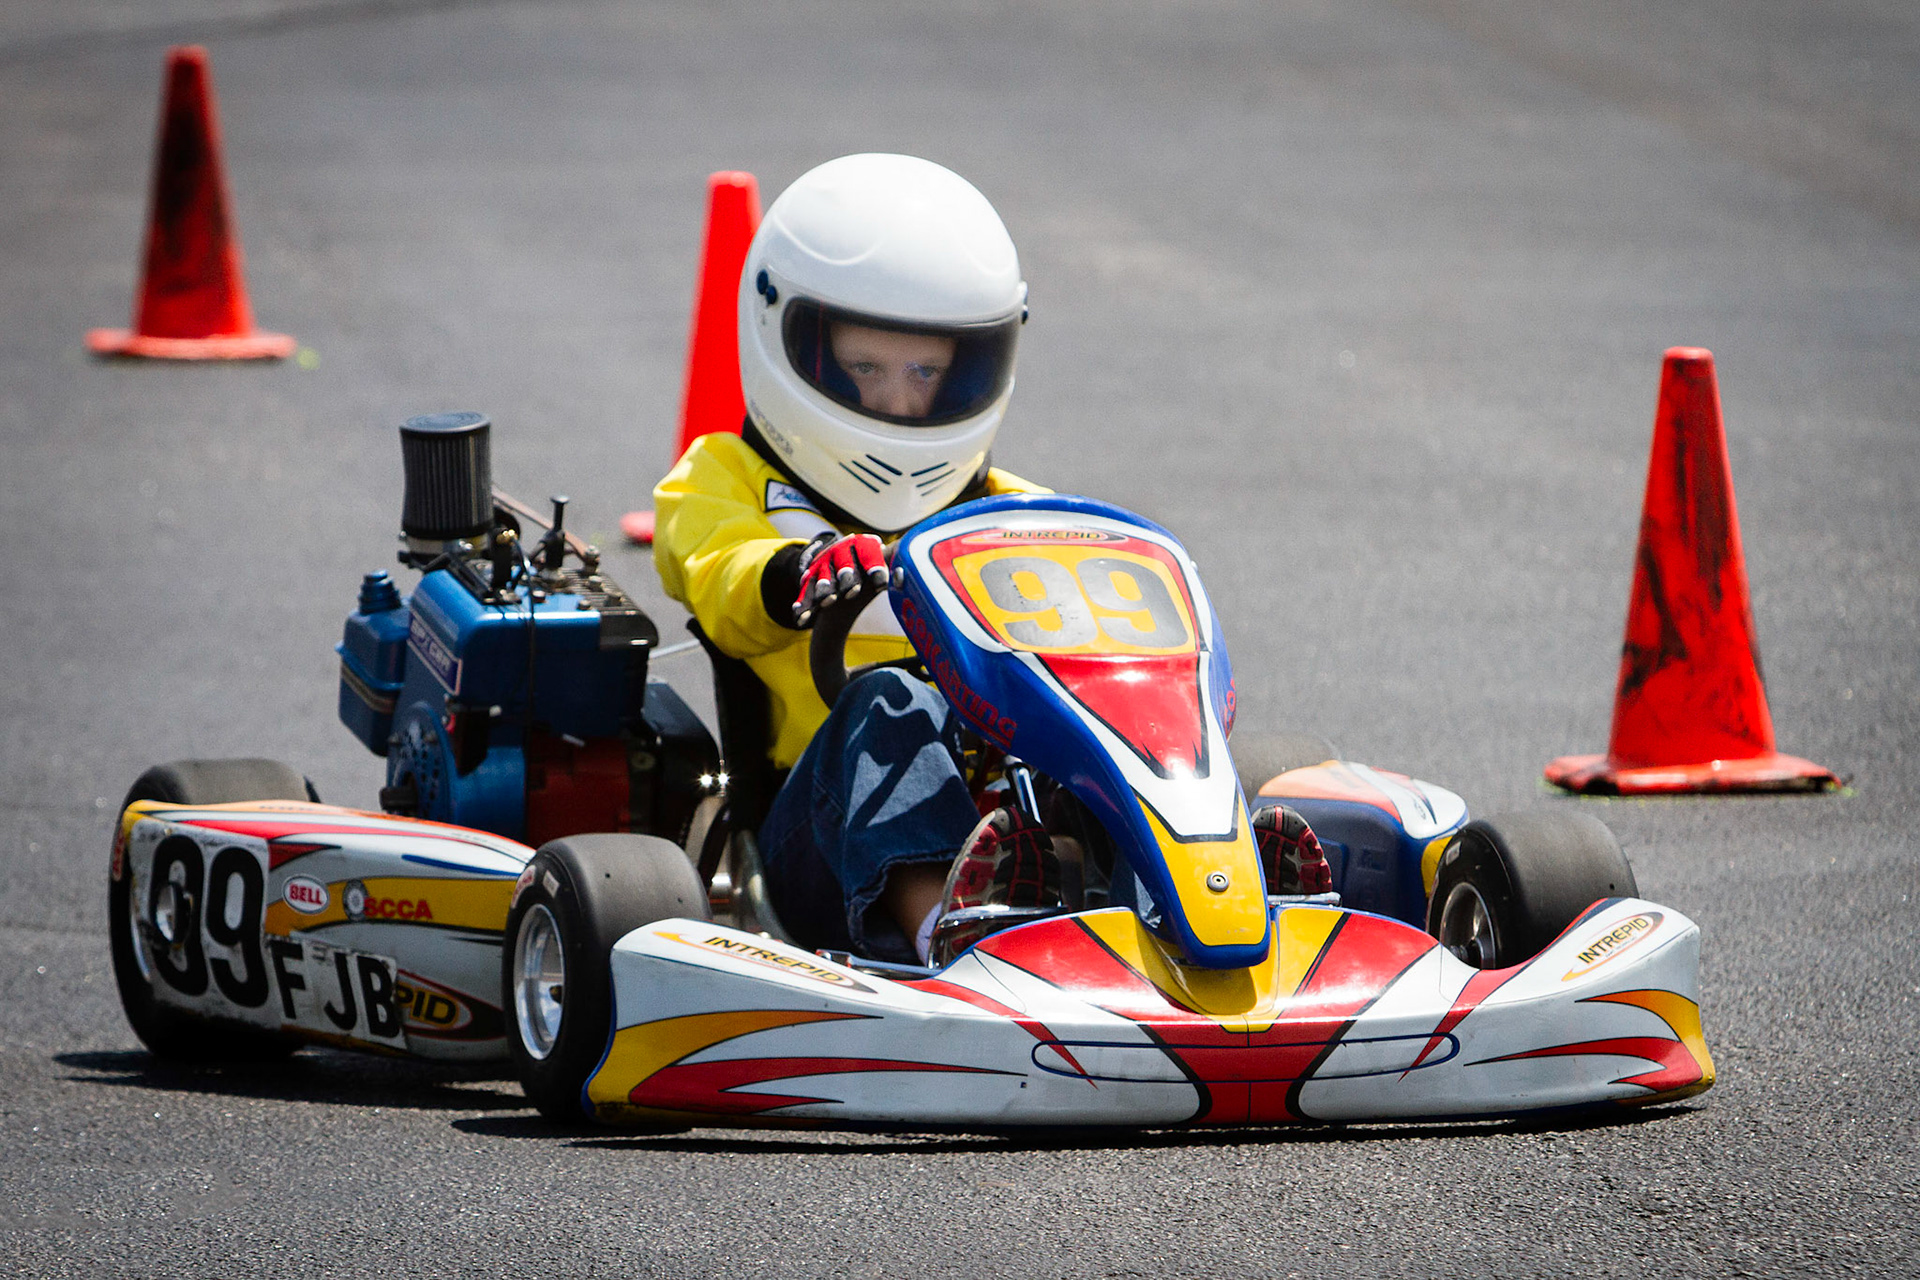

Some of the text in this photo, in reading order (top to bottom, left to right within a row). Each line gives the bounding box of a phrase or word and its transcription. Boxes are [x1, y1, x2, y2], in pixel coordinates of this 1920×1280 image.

[1003, 531, 1100, 539] INTREPID
[980, 556, 1188, 648] 99
[291, 883, 322, 905] BELL
[364, 898, 432, 919] SCCA
[1578, 917, 1649, 964] INTREPID
[703, 936, 843, 981] INTREPID
